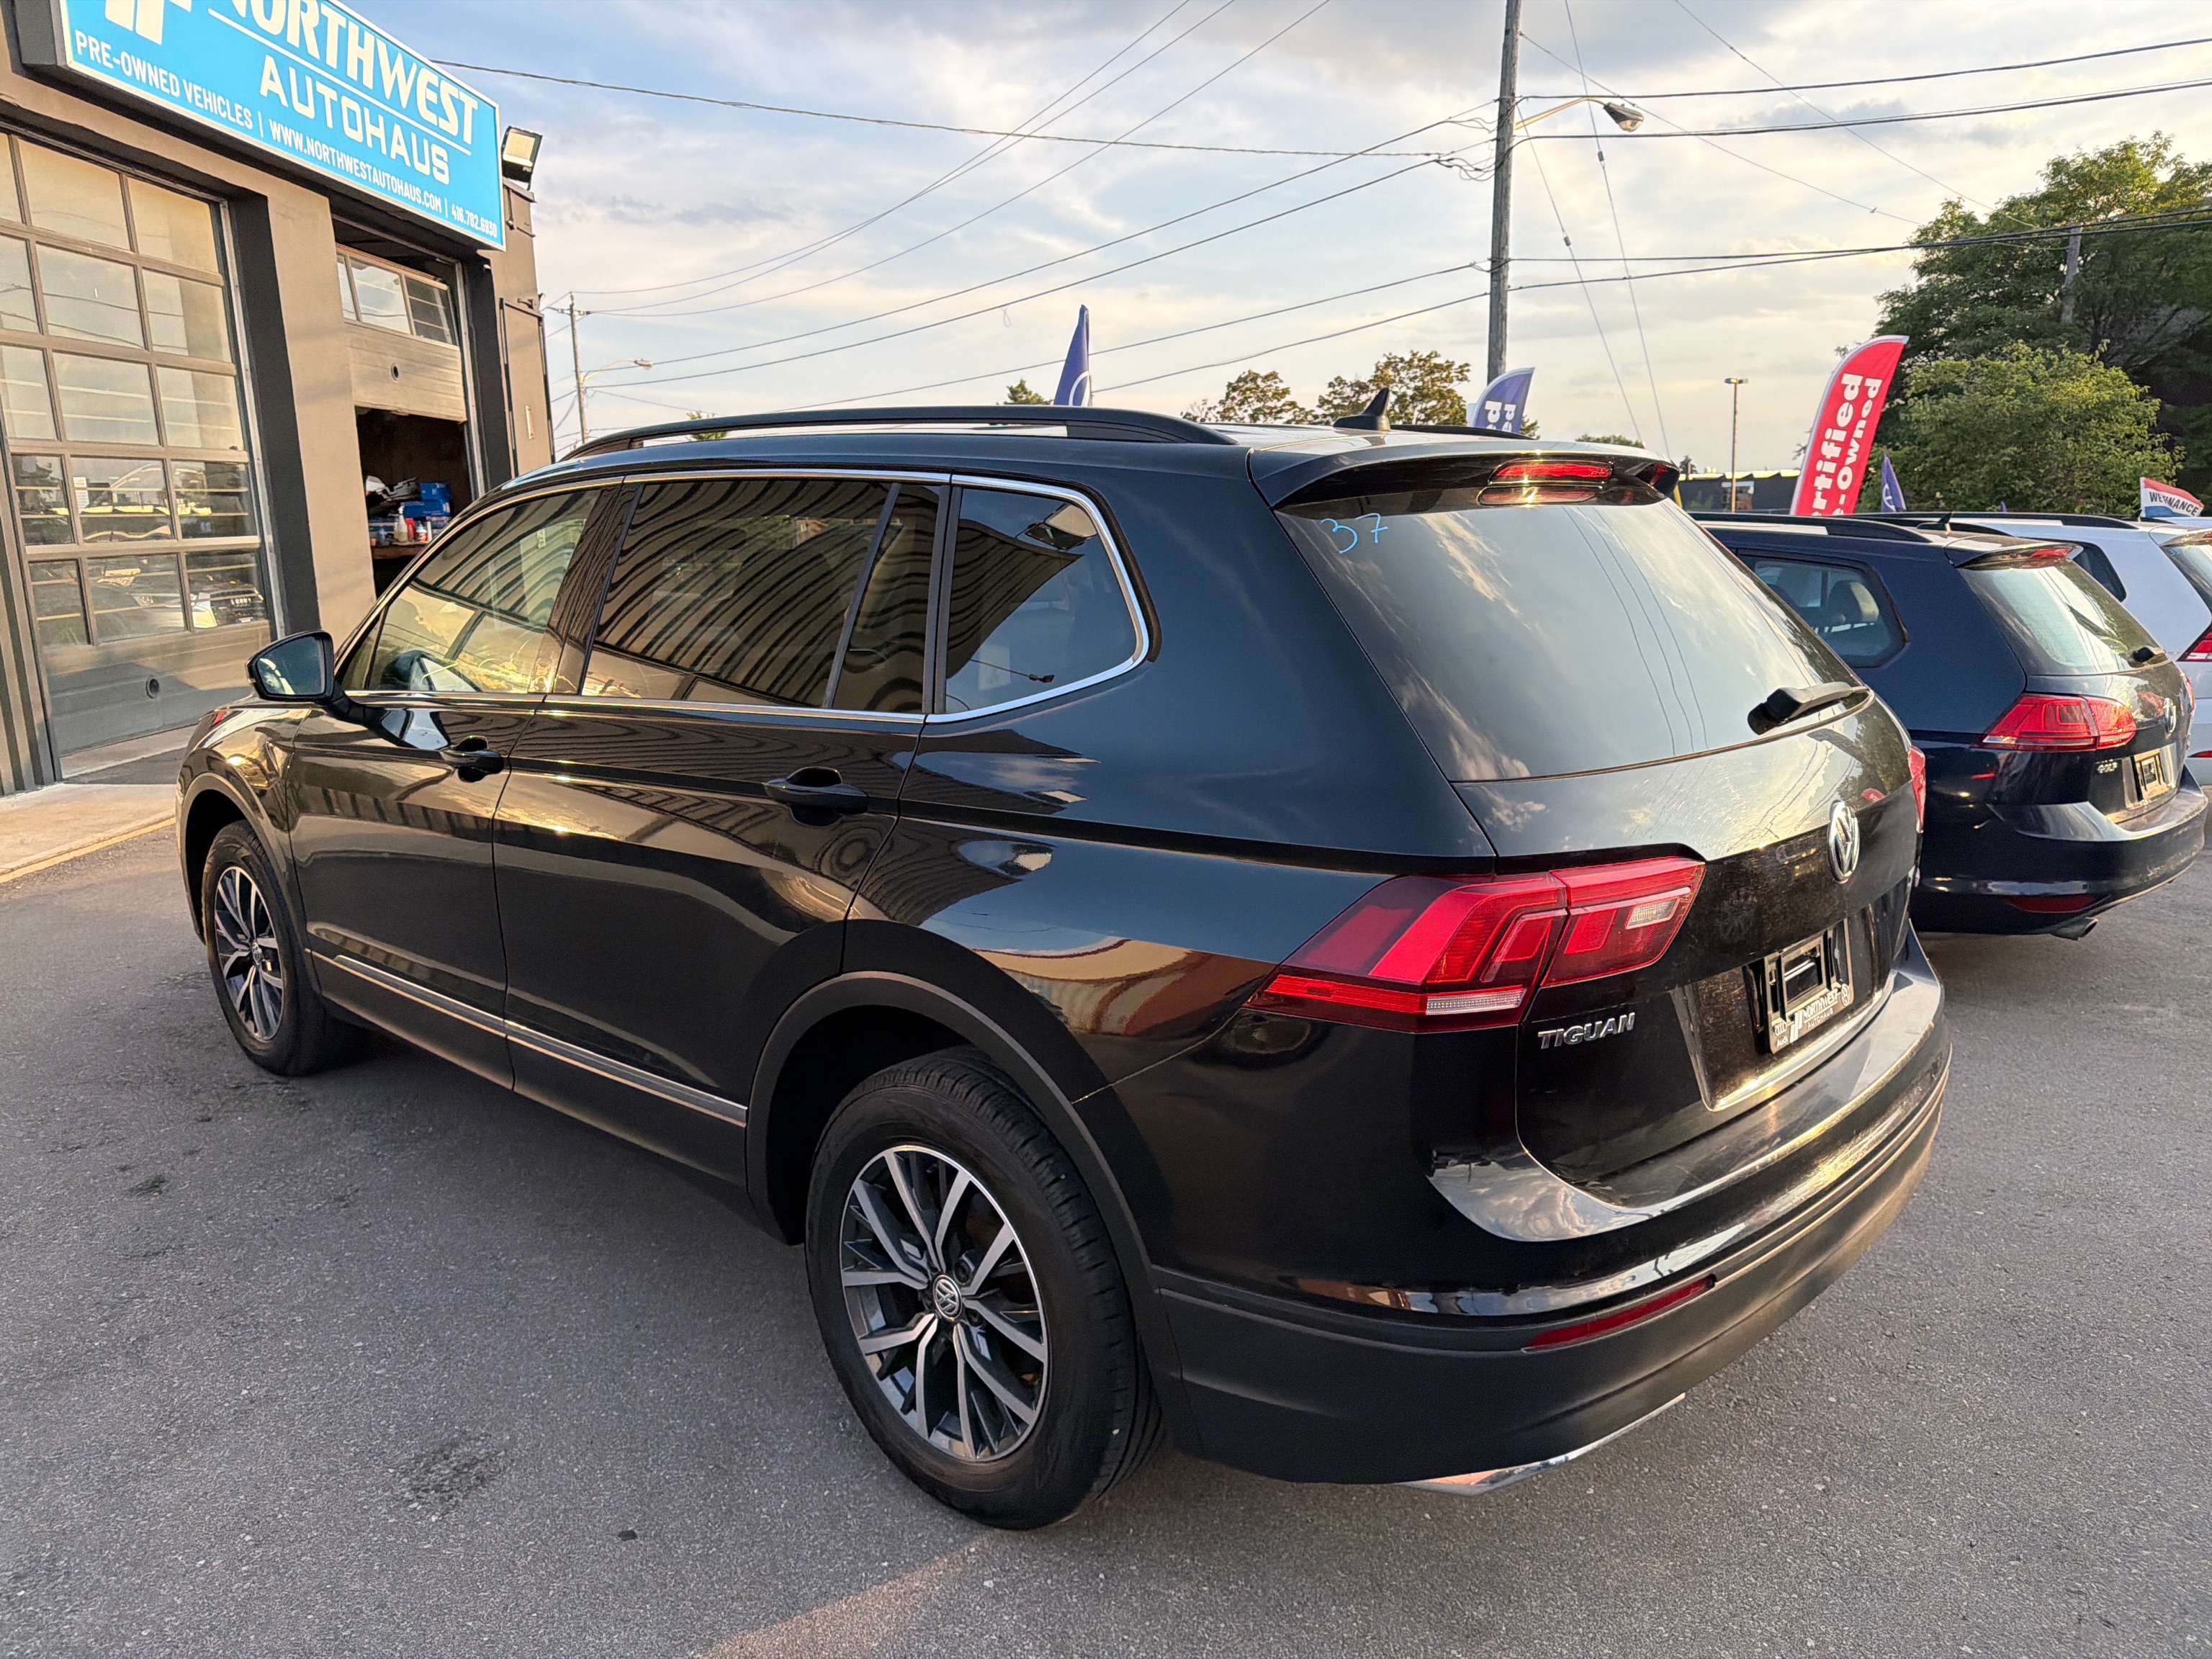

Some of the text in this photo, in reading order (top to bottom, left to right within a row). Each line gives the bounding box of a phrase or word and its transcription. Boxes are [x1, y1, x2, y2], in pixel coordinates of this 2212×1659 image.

[232, 0, 477, 145] ORTHWEST
[75, 29, 179, 97] PRE-OWNED
[182, 78, 253, 130] VEHICLES
[269, 119, 442, 214] WWW.NORTHWESTAUTOHAUS.COM
[260, 54, 449, 185] AUTOHAUS
[2149, 491, 2163, 503] WE
[1320, 512, 1388, 554] 37
[1803, 989, 1839, 1019] NORTHWEST
[1807, 1008, 1833, 1030] AUTOHAUS
[1537, 1012, 1635, 1049] TIGUAN
